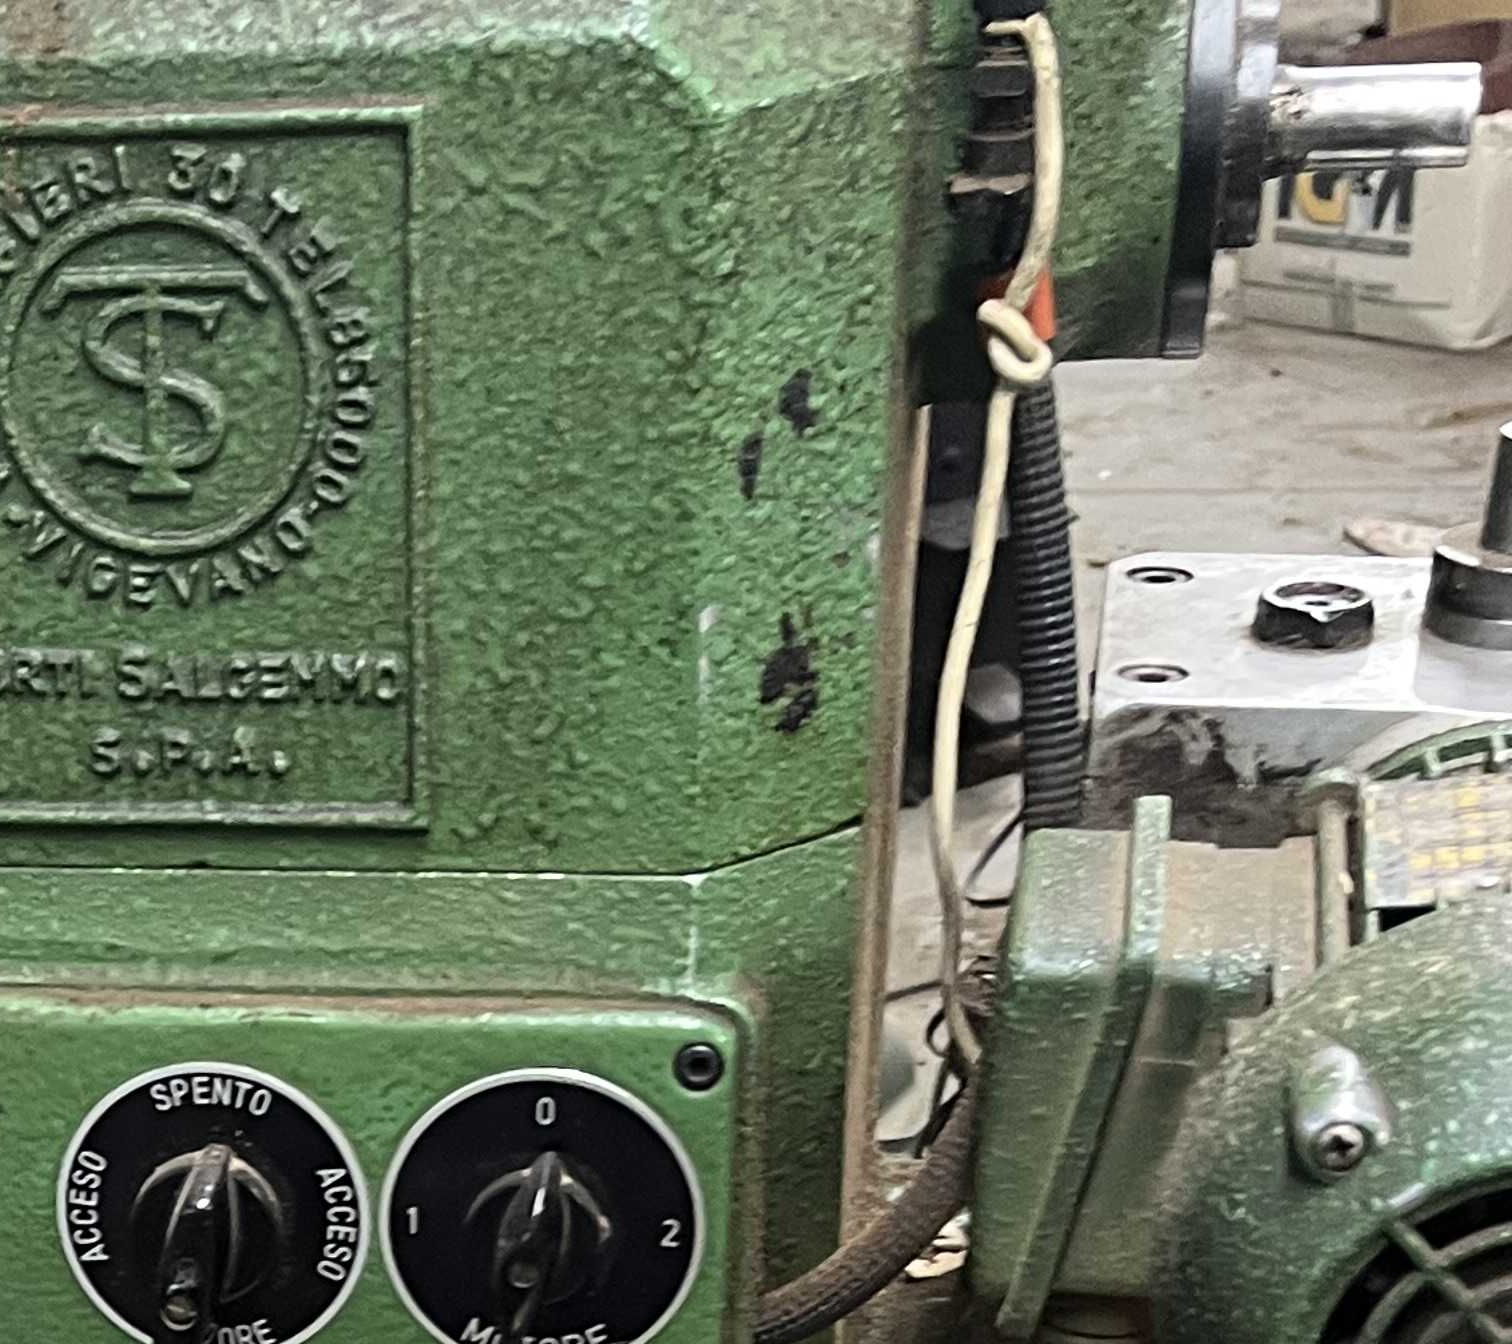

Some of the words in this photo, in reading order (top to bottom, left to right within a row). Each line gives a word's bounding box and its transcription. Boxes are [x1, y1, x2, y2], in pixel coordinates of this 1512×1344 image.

[167, 144, 247, 204] 30
[115, 640, 404, 704] SALGEMMO
[90, 726, 288, 778] S.P.A.
[150, 1077, 273, 1117] SPENTO
[535, 1097, 556, 1126] 0
[70, 1151, 109, 1264] ACCESO
[315, 1167, 358, 1283] ACCESO
[406, 1207, 419, 1235] 1
[659, 1221, 682, 1249] 2
